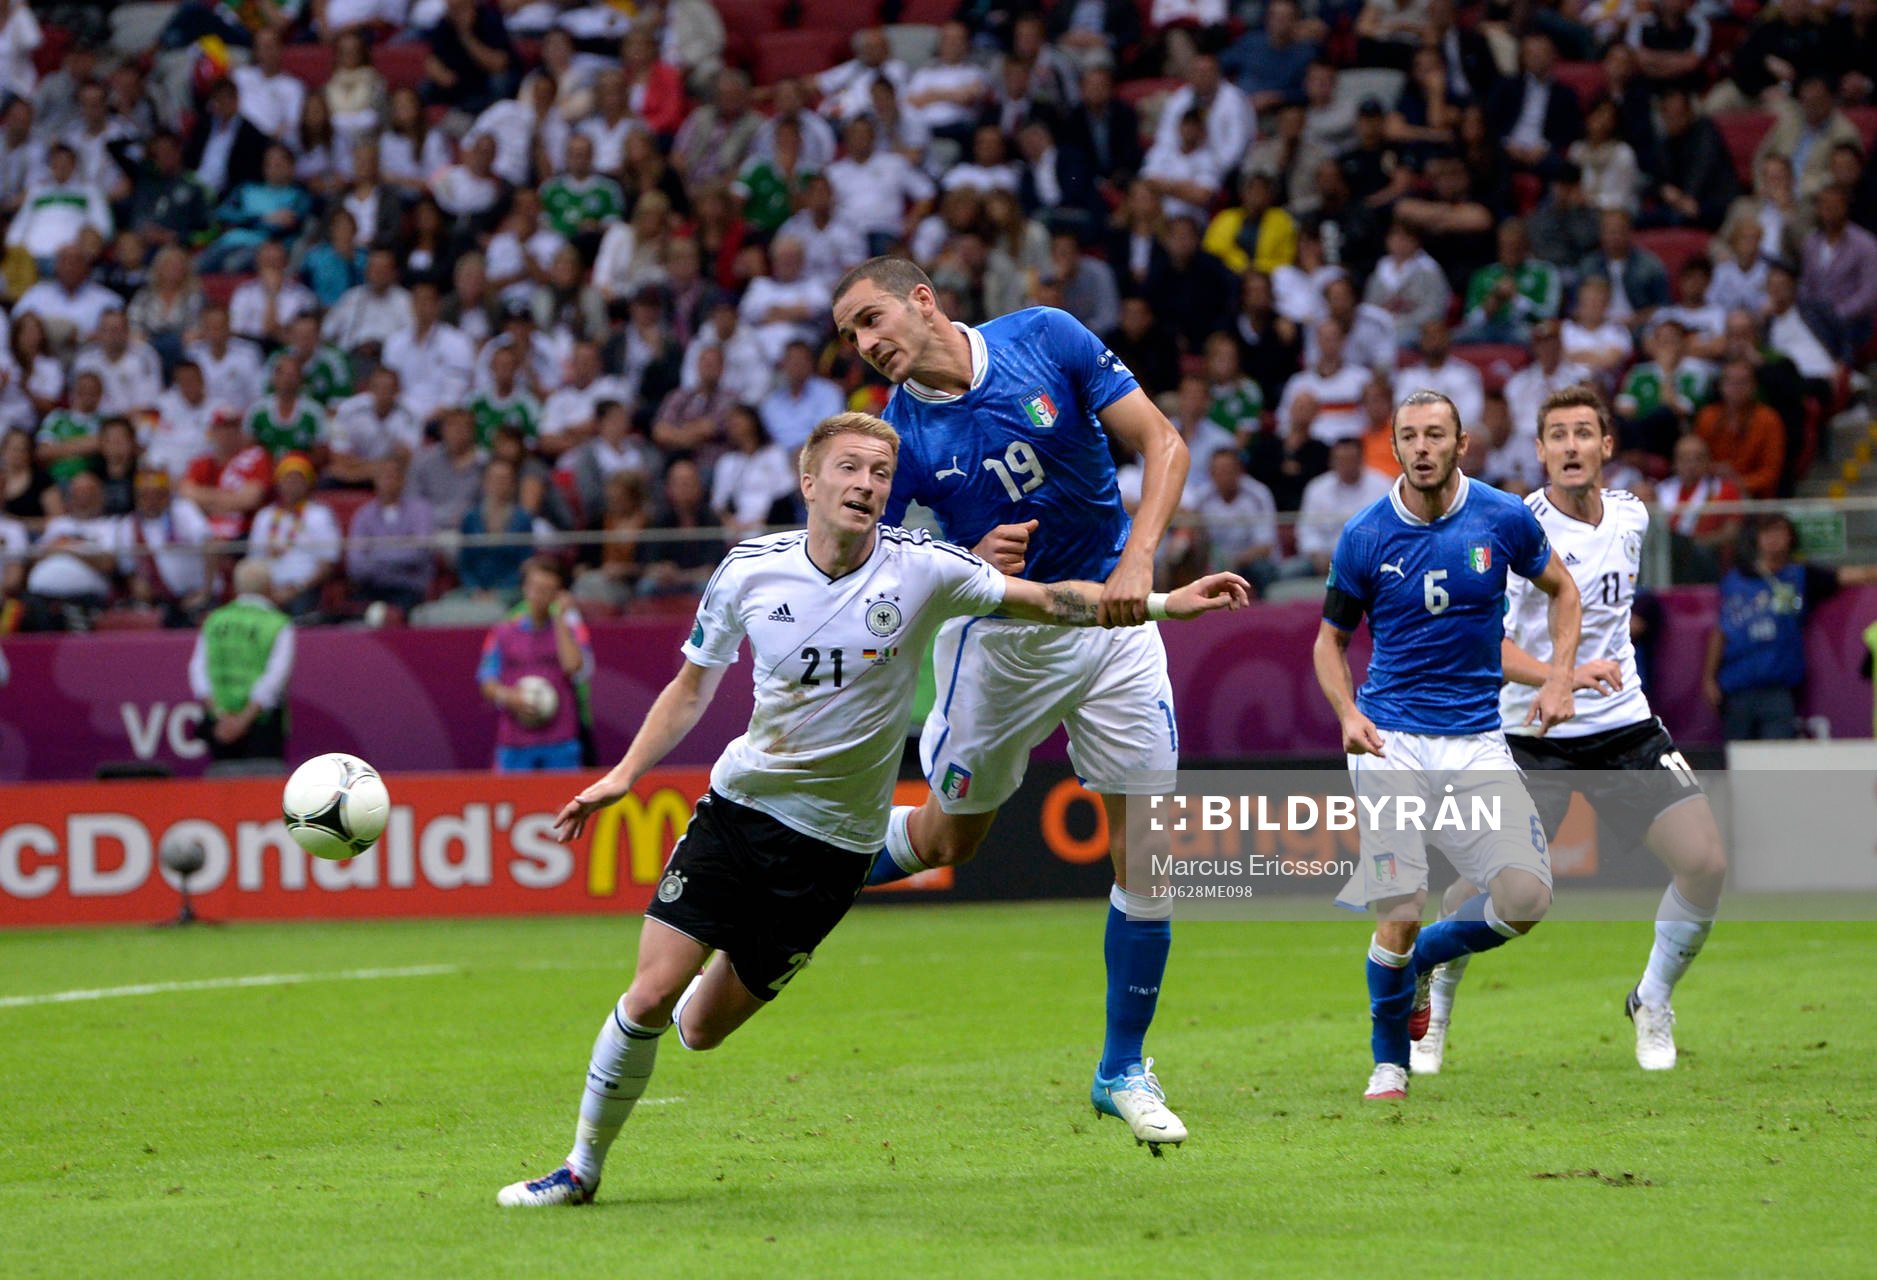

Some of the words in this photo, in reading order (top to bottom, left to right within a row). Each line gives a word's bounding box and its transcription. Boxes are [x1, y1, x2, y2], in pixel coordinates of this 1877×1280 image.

[982, 440, 1045, 503] 19
[1424, 568, 1449, 616] 6
[1601, 571, 1620, 604] 11
[767, 613, 796, 624] adidas
[800, 646, 844, 688] 21
[1659, 750, 1699, 788] 11
[1529, 814, 1546, 854] 6
